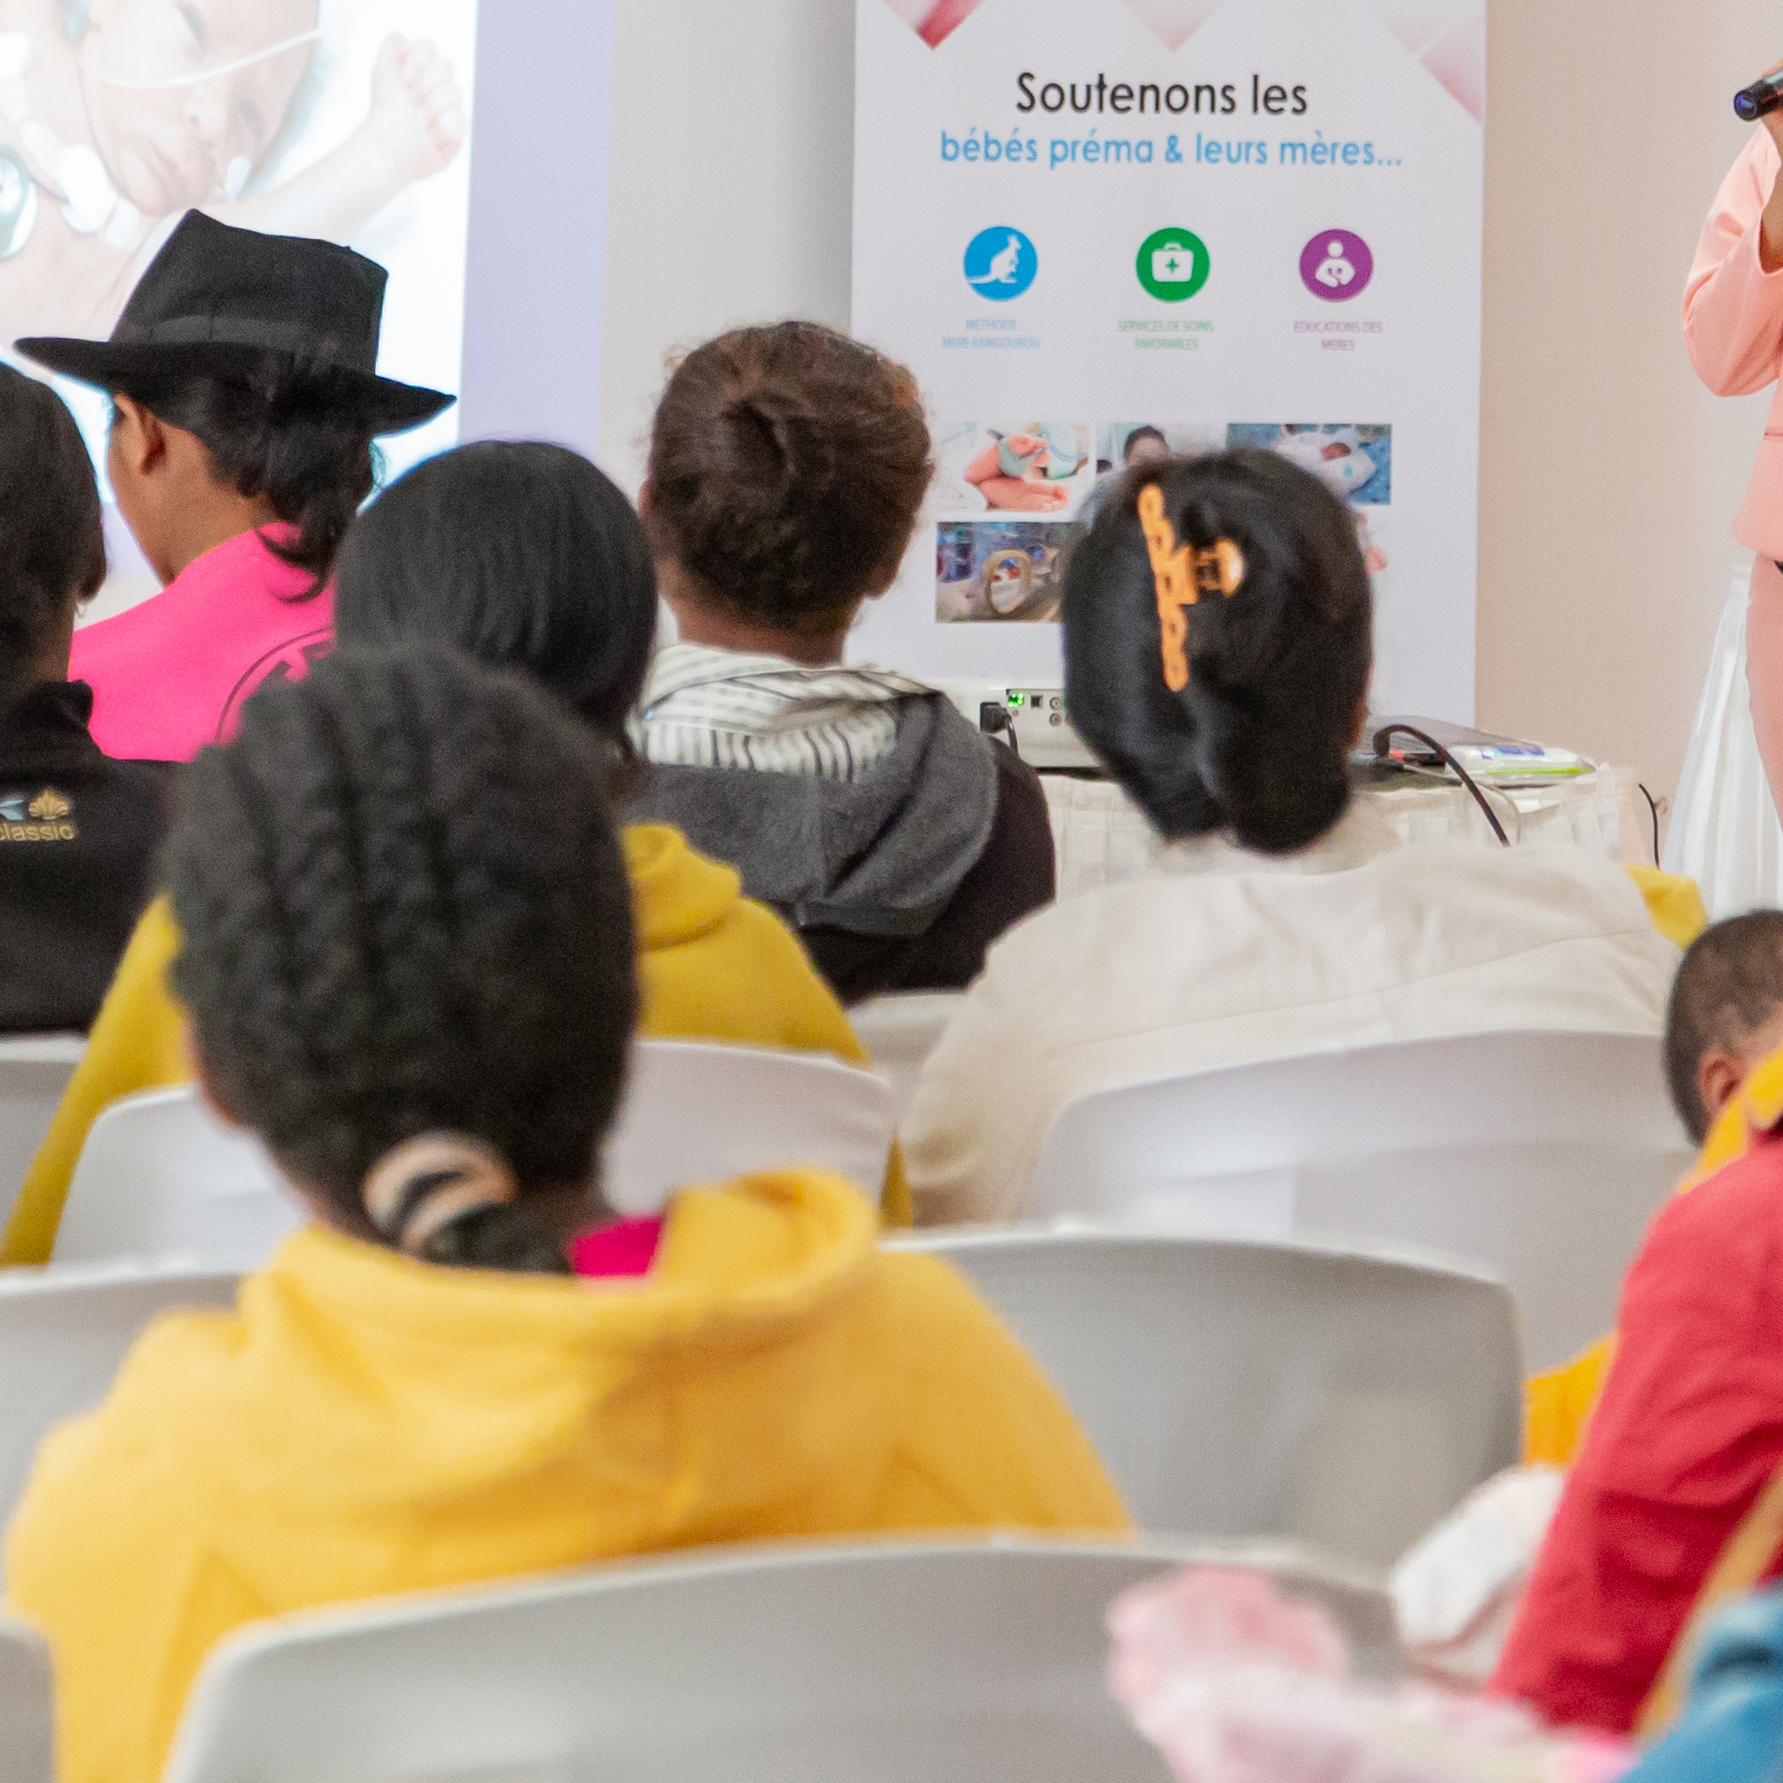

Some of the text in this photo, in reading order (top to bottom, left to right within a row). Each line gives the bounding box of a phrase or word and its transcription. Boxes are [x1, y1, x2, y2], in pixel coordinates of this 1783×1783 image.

[1016, 71, 1309, 116] Soutenons les
[941, 126, 1403, 170] bébés préma & leurs mères...
